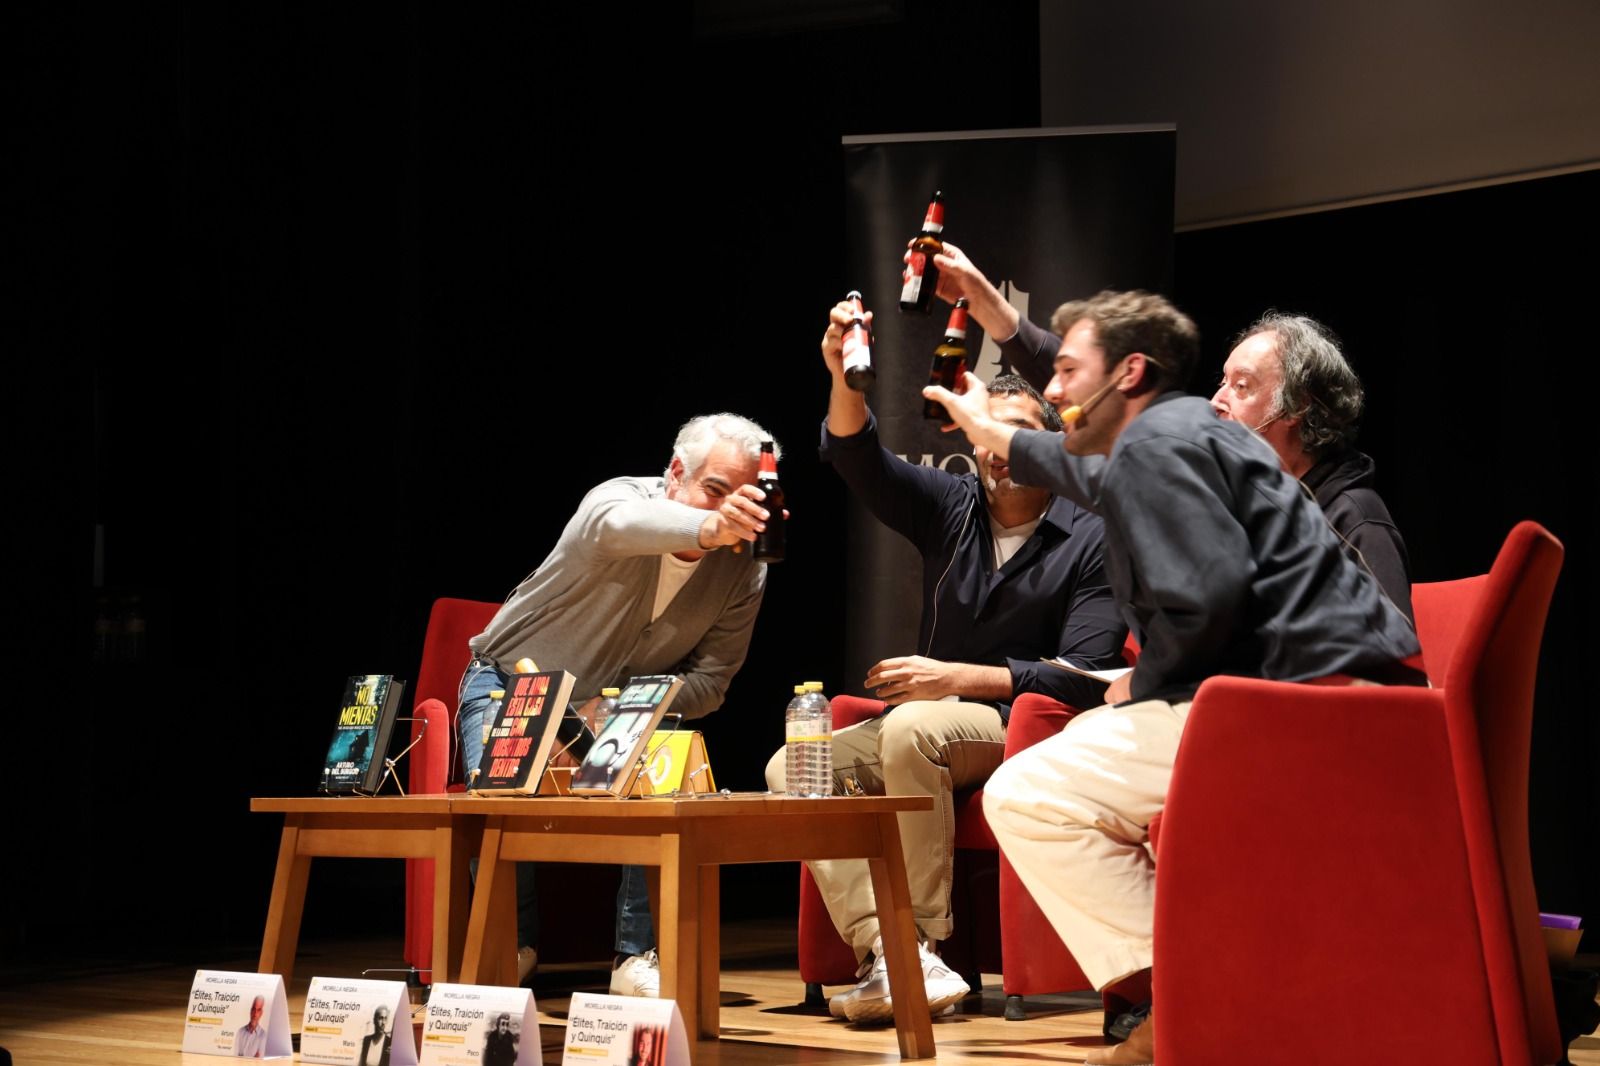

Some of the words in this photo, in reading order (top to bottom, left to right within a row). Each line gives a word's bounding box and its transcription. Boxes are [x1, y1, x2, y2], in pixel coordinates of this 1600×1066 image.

[356, 686, 370, 705] NO
[339, 705, 378, 725] MIENTAS
[214, 991, 240, 1003] Traición
[192, 1004, 197, 1014] y
[332, 1000, 361, 1011] Traición
[308, 1013, 313, 1023] y
[454, 1007, 484, 1019] Traición
[428, 1021, 434, 1031] y
[597, 1019, 628, 1031] Traición
[571, 1032, 577, 1043] y
